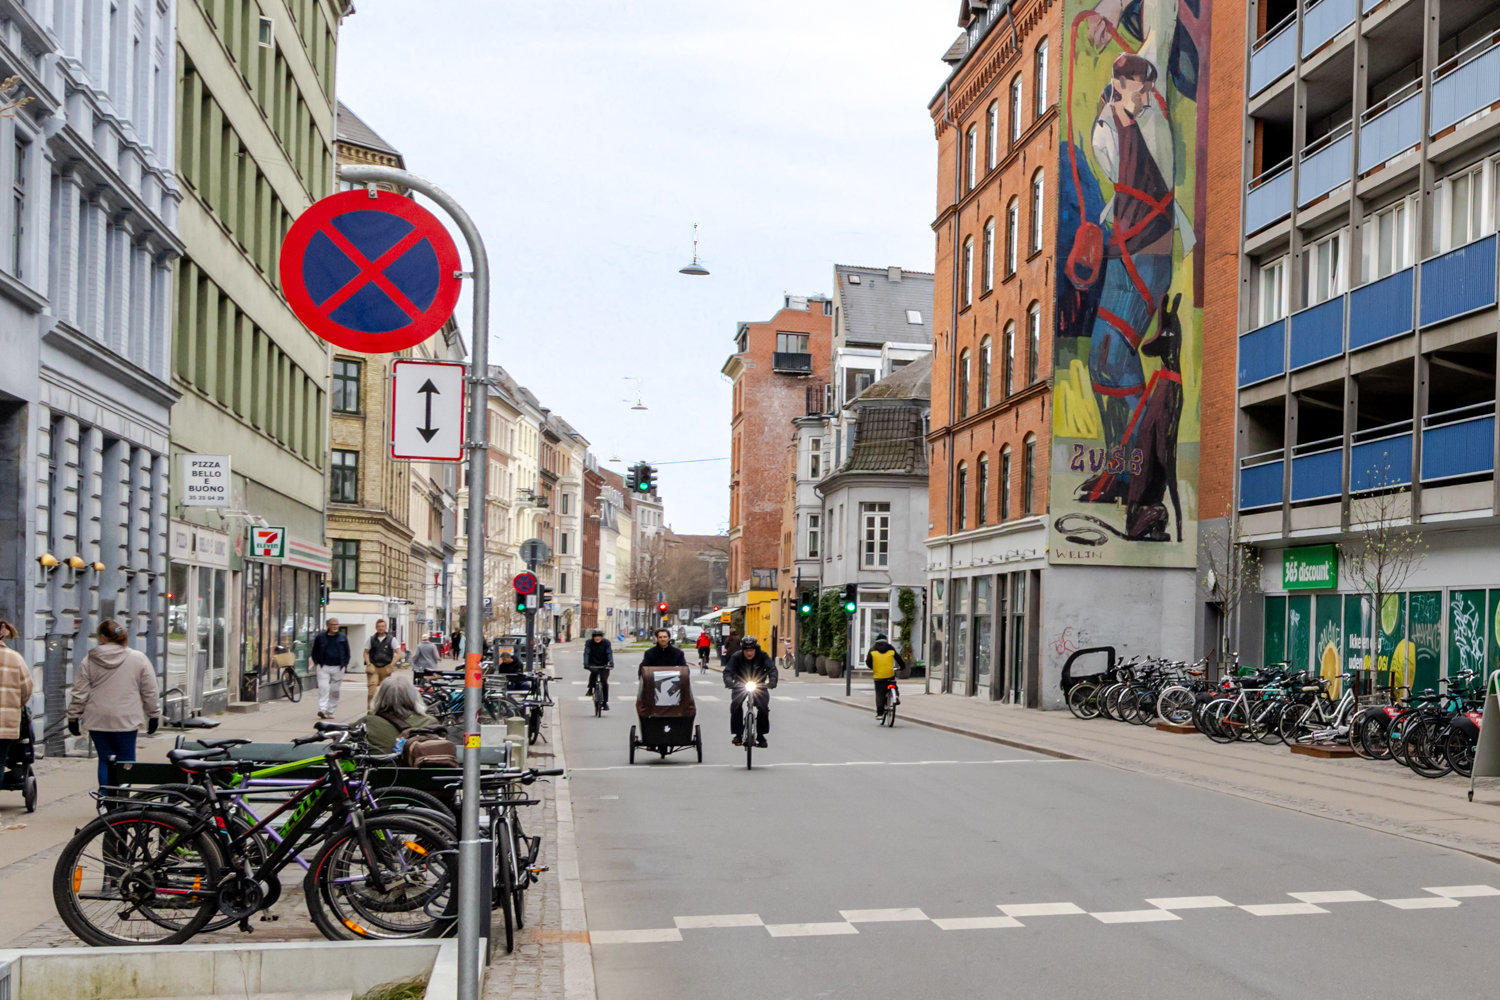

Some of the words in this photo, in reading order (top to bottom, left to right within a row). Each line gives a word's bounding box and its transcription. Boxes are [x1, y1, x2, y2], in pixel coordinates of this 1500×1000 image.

[192, 470, 222, 478] BELLO
[188, 485, 225, 493] BUONO
[258, 531, 278, 556] 7
[1285, 561, 1298, 583] 365
[1299, 560, 1329, 582] discount
